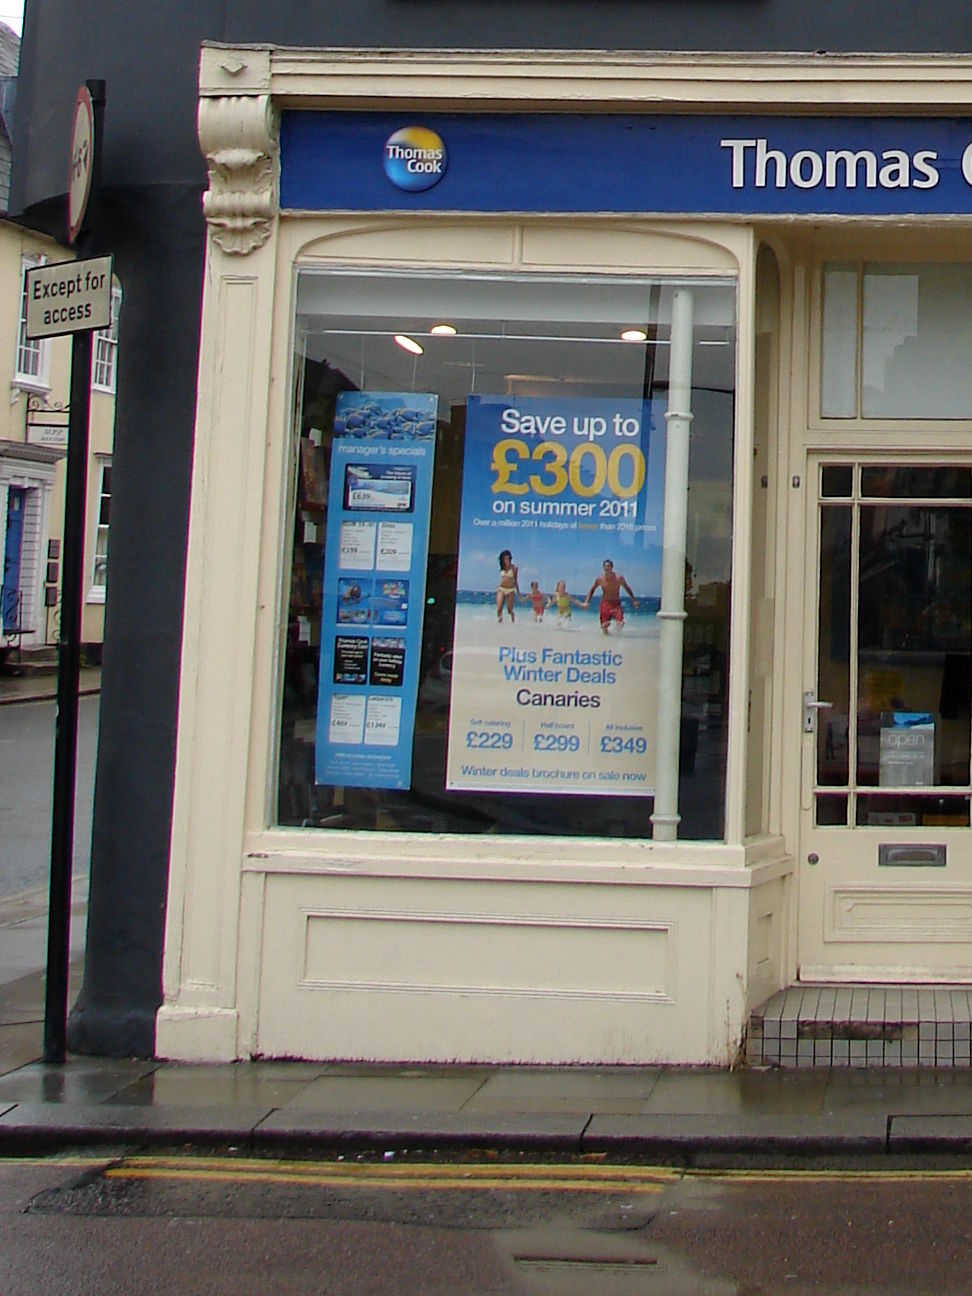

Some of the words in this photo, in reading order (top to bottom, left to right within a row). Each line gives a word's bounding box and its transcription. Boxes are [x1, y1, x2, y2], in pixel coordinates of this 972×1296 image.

[386, 145, 443, 160] Thomas
[407, 159, 442, 174] Cook
[720, 138, 939, 190] Thomas
[33, 274, 82, 300] Except
[85, 271, 106, 291] for
[44, 302, 92, 325] access
[501, 408, 566, 436] Save
[573, 417, 606, 441] up
[613, 413, 639, 437] to
[491, 438, 646, 498] £300
[492, 500, 516, 514] on
[520, 502, 595, 517] summer
[599, 500, 638, 517] 2011
[499, 646, 537, 664] Plus
[541, 648, 623, 667] Fantastic
[503, 665, 562, 683] Winter
[566, 667, 617, 685] Deals
[516, 688, 601, 708] Canaries
[466, 730, 513, 750] £229
[533, 733, 581, 753] £299
[600, 736, 648, 755] £349
[888, 734, 926, 749] open
[461, 764, 498, 777] Winter
[499, 766, 529, 778] deals
[532, 767, 580, 780] brochure
[582, 770, 596, 780] on
[598, 769, 620, 781] sale
[622, 771, 647, 782] now
